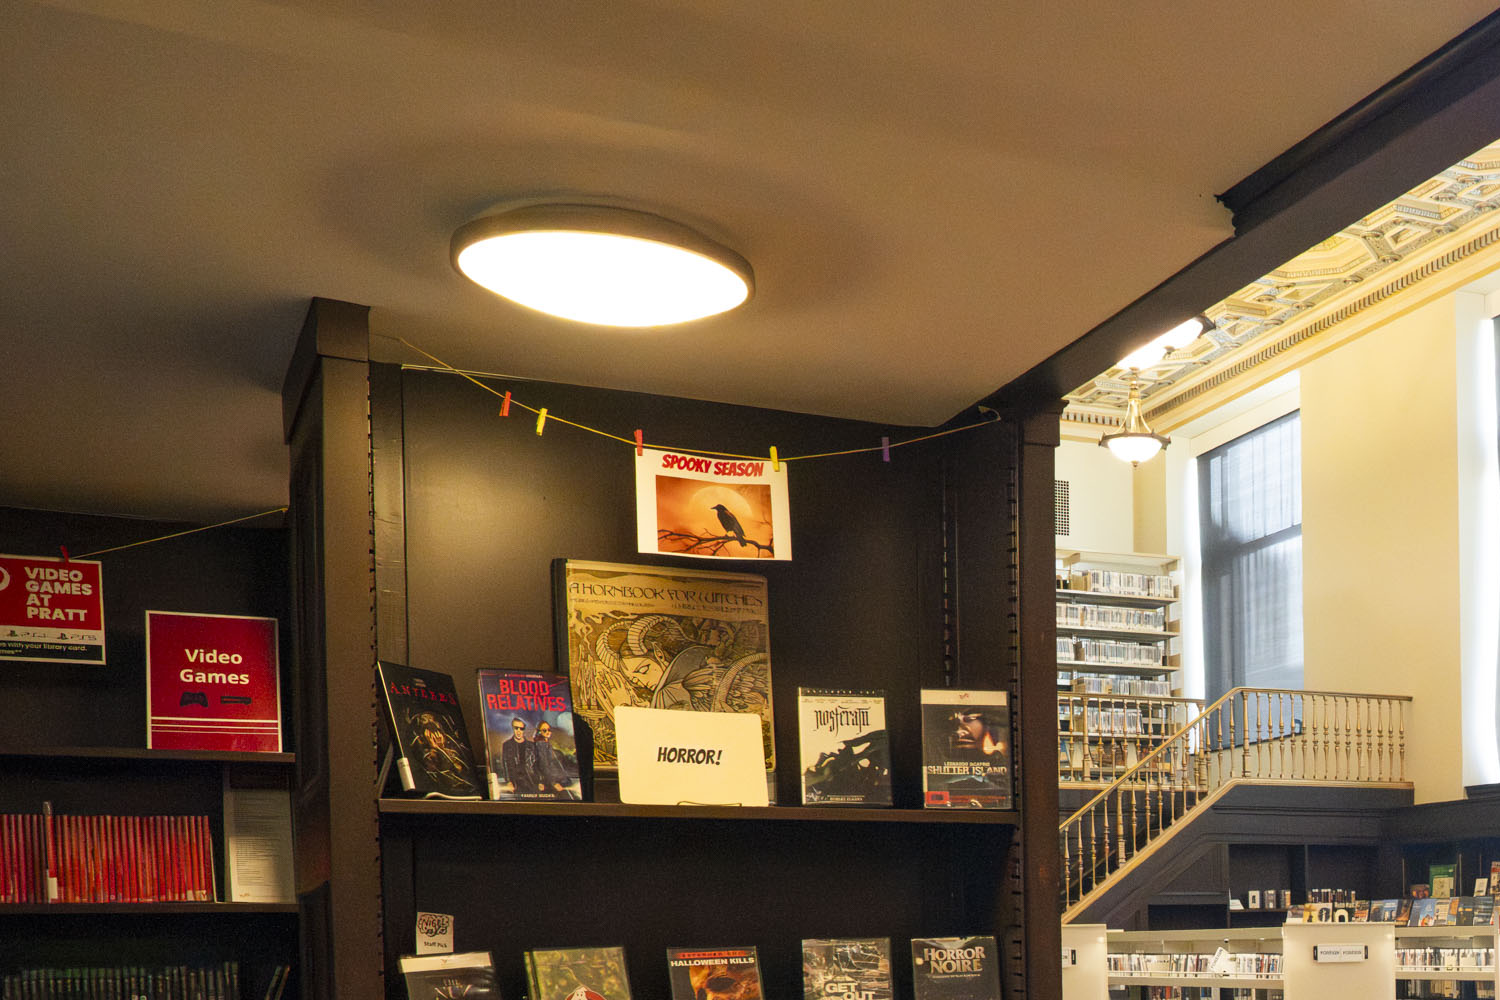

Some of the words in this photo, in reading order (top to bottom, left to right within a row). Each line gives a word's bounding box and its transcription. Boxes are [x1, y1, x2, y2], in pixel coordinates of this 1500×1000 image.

[662, 454, 711, 475] SPOOKY
[714, 460, 764, 478] SEASON
[24, 567, 83, 582] VIDEO
[25, 581, 93, 596] GAMES
[569, 582, 580, 594] A
[582, 583, 665, 600] HORNBOOK
[667, 589, 696, 601] FOR
[26, 594, 52, 607] AT
[26, 607, 88, 622] PRATT
[184, 649, 243, 664] Video
[180, 669, 250, 685] Games
[499, 679, 551, 697] BLOOD
[486, 693, 567, 712] RELATIVES
[657, 746, 722, 766] HORROR!
[927, 766, 970, 776] SHUTTER
[971, 766, 1007, 777] ISLAND
[924, 947, 986, 961] HORROR
[671, 958, 728, 967] HALLOWEEN
[729, 957, 755, 965] KILLS
[930, 959, 983, 973] NOIRE
[825, 982, 858, 993] GET
[843, 991, 875, 1000] OUT
